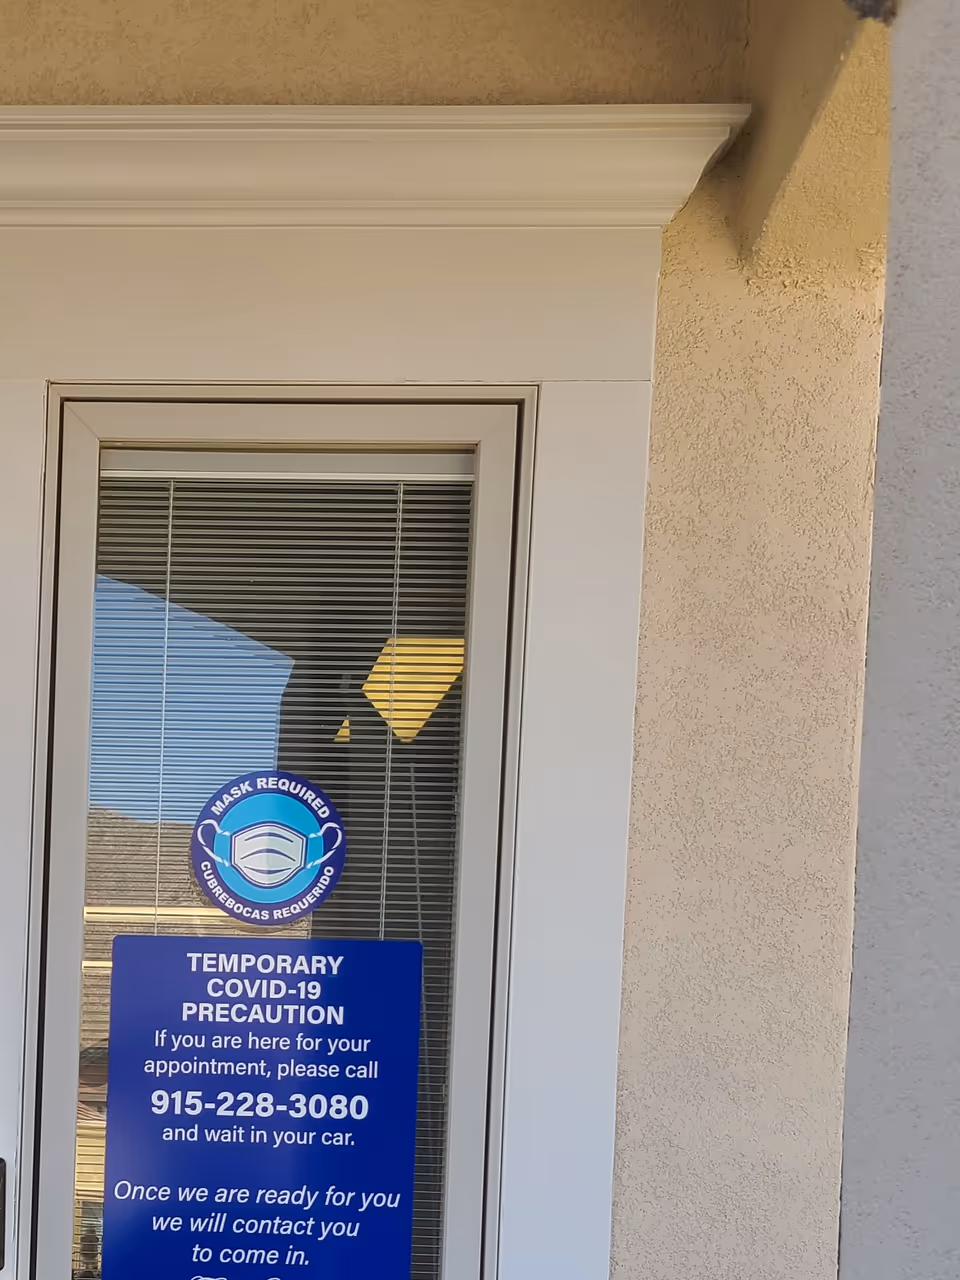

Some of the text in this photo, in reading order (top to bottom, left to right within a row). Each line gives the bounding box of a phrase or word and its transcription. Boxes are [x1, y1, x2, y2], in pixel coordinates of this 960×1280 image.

[210, 777, 330, 819] MASK REQUIRED
[200, 861, 335, 920] CUBREBOCAS REQUERIDO
[187, 952, 344, 975] TEMPORARY
[206, 978, 322, 1000] COVID-19
[182, 1002, 344, 1025] PRECAUTION
[155, 1030, 371, 1054] If you are here for your
[144, 1057, 378, 1080] appointment, please call
[151, 1090, 369, 1120] 915-228-3080
[162, 1124, 355, 1148] and wait in your car.
[113, 1180, 400, 1212] Once we are ready for you
[152, 1213, 360, 1241] we will contact you
[192, 1244, 310, 1265] to come in.
